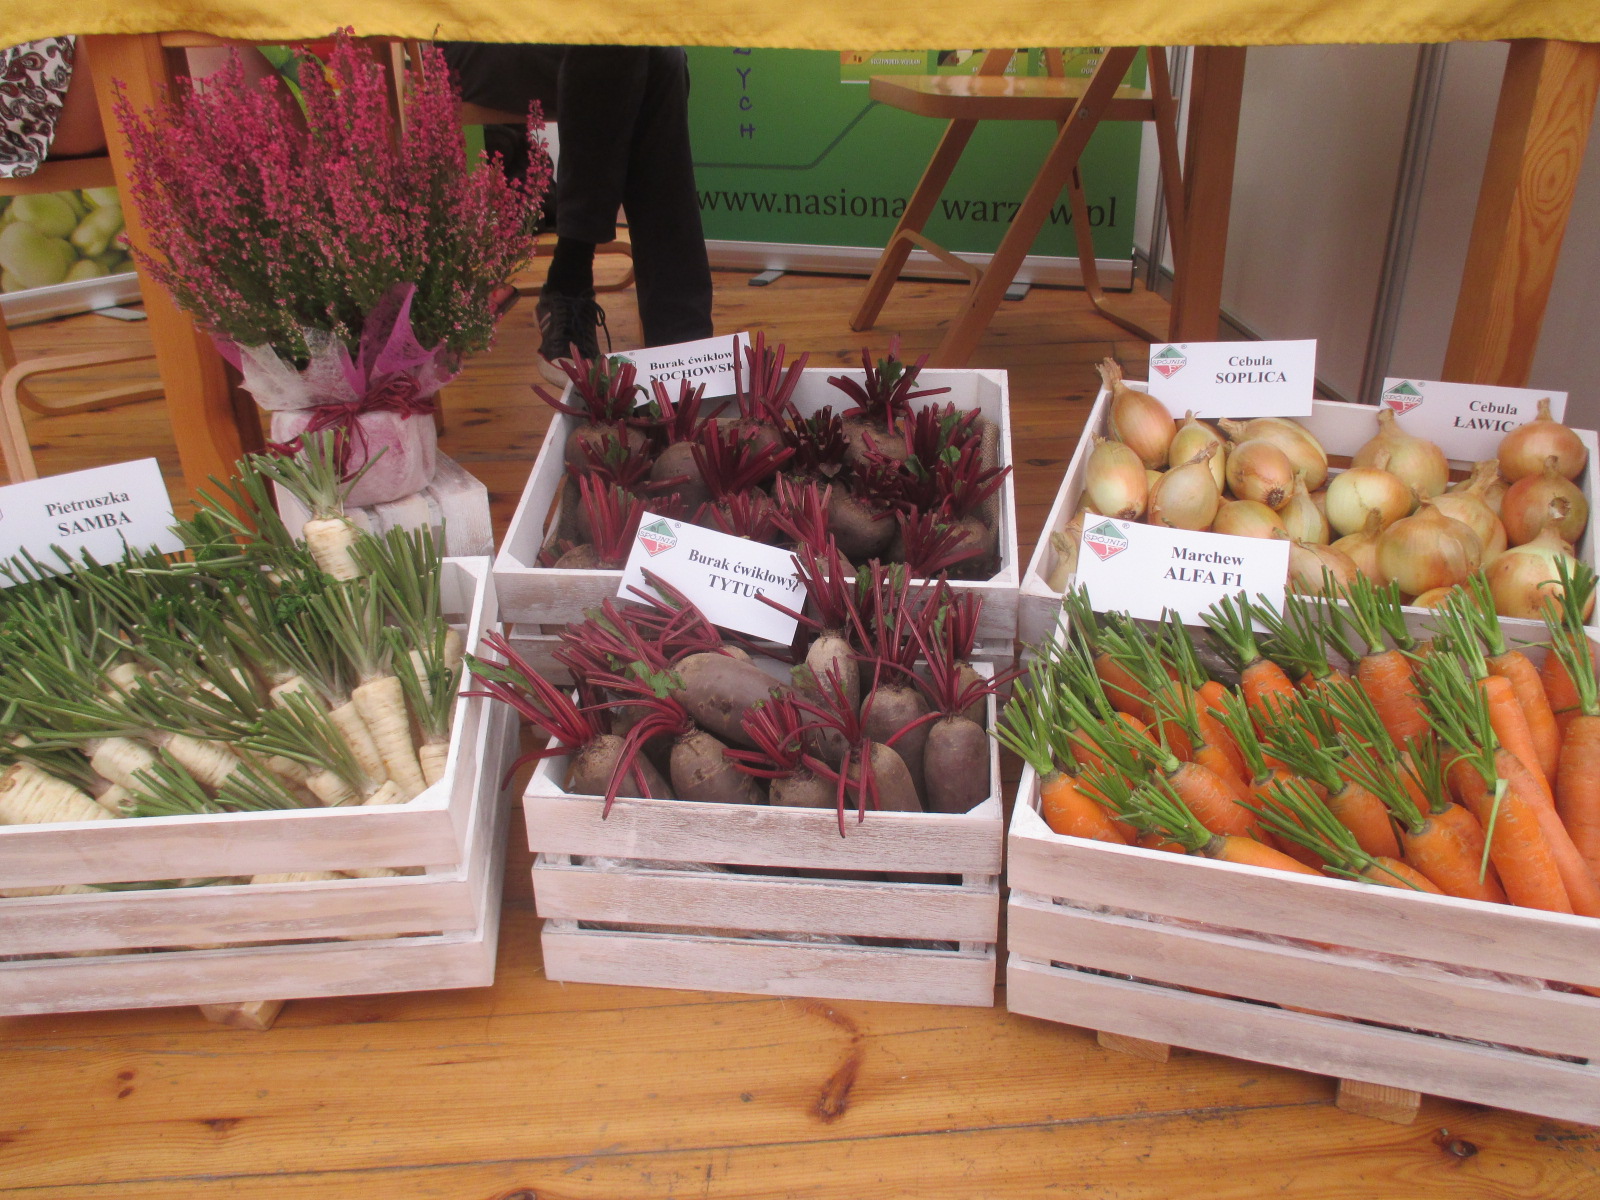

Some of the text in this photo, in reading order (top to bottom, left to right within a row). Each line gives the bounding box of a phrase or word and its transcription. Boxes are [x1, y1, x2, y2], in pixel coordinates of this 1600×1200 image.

[649, 351, 735, 371] Burak ćwikłow
[1228, 355, 1273, 367] Cebula
[649, 360, 743, 383] NOCHOWSK
[1215, 371, 1287, 384] SOPLICA
[1469, 400, 1518, 415] Cebula
[1453, 416, 1522, 433] ŁAWIC
[45, 491, 131, 517] Pietruszka
[58, 510, 133, 537] SAMBA
[1171, 546, 1245, 566] Marchew
[688, 549, 797, 592] Burak ćwikłowy
[1163, 566, 1243, 587] ALFA F1
[709, 573, 766, 599] TYTUS
